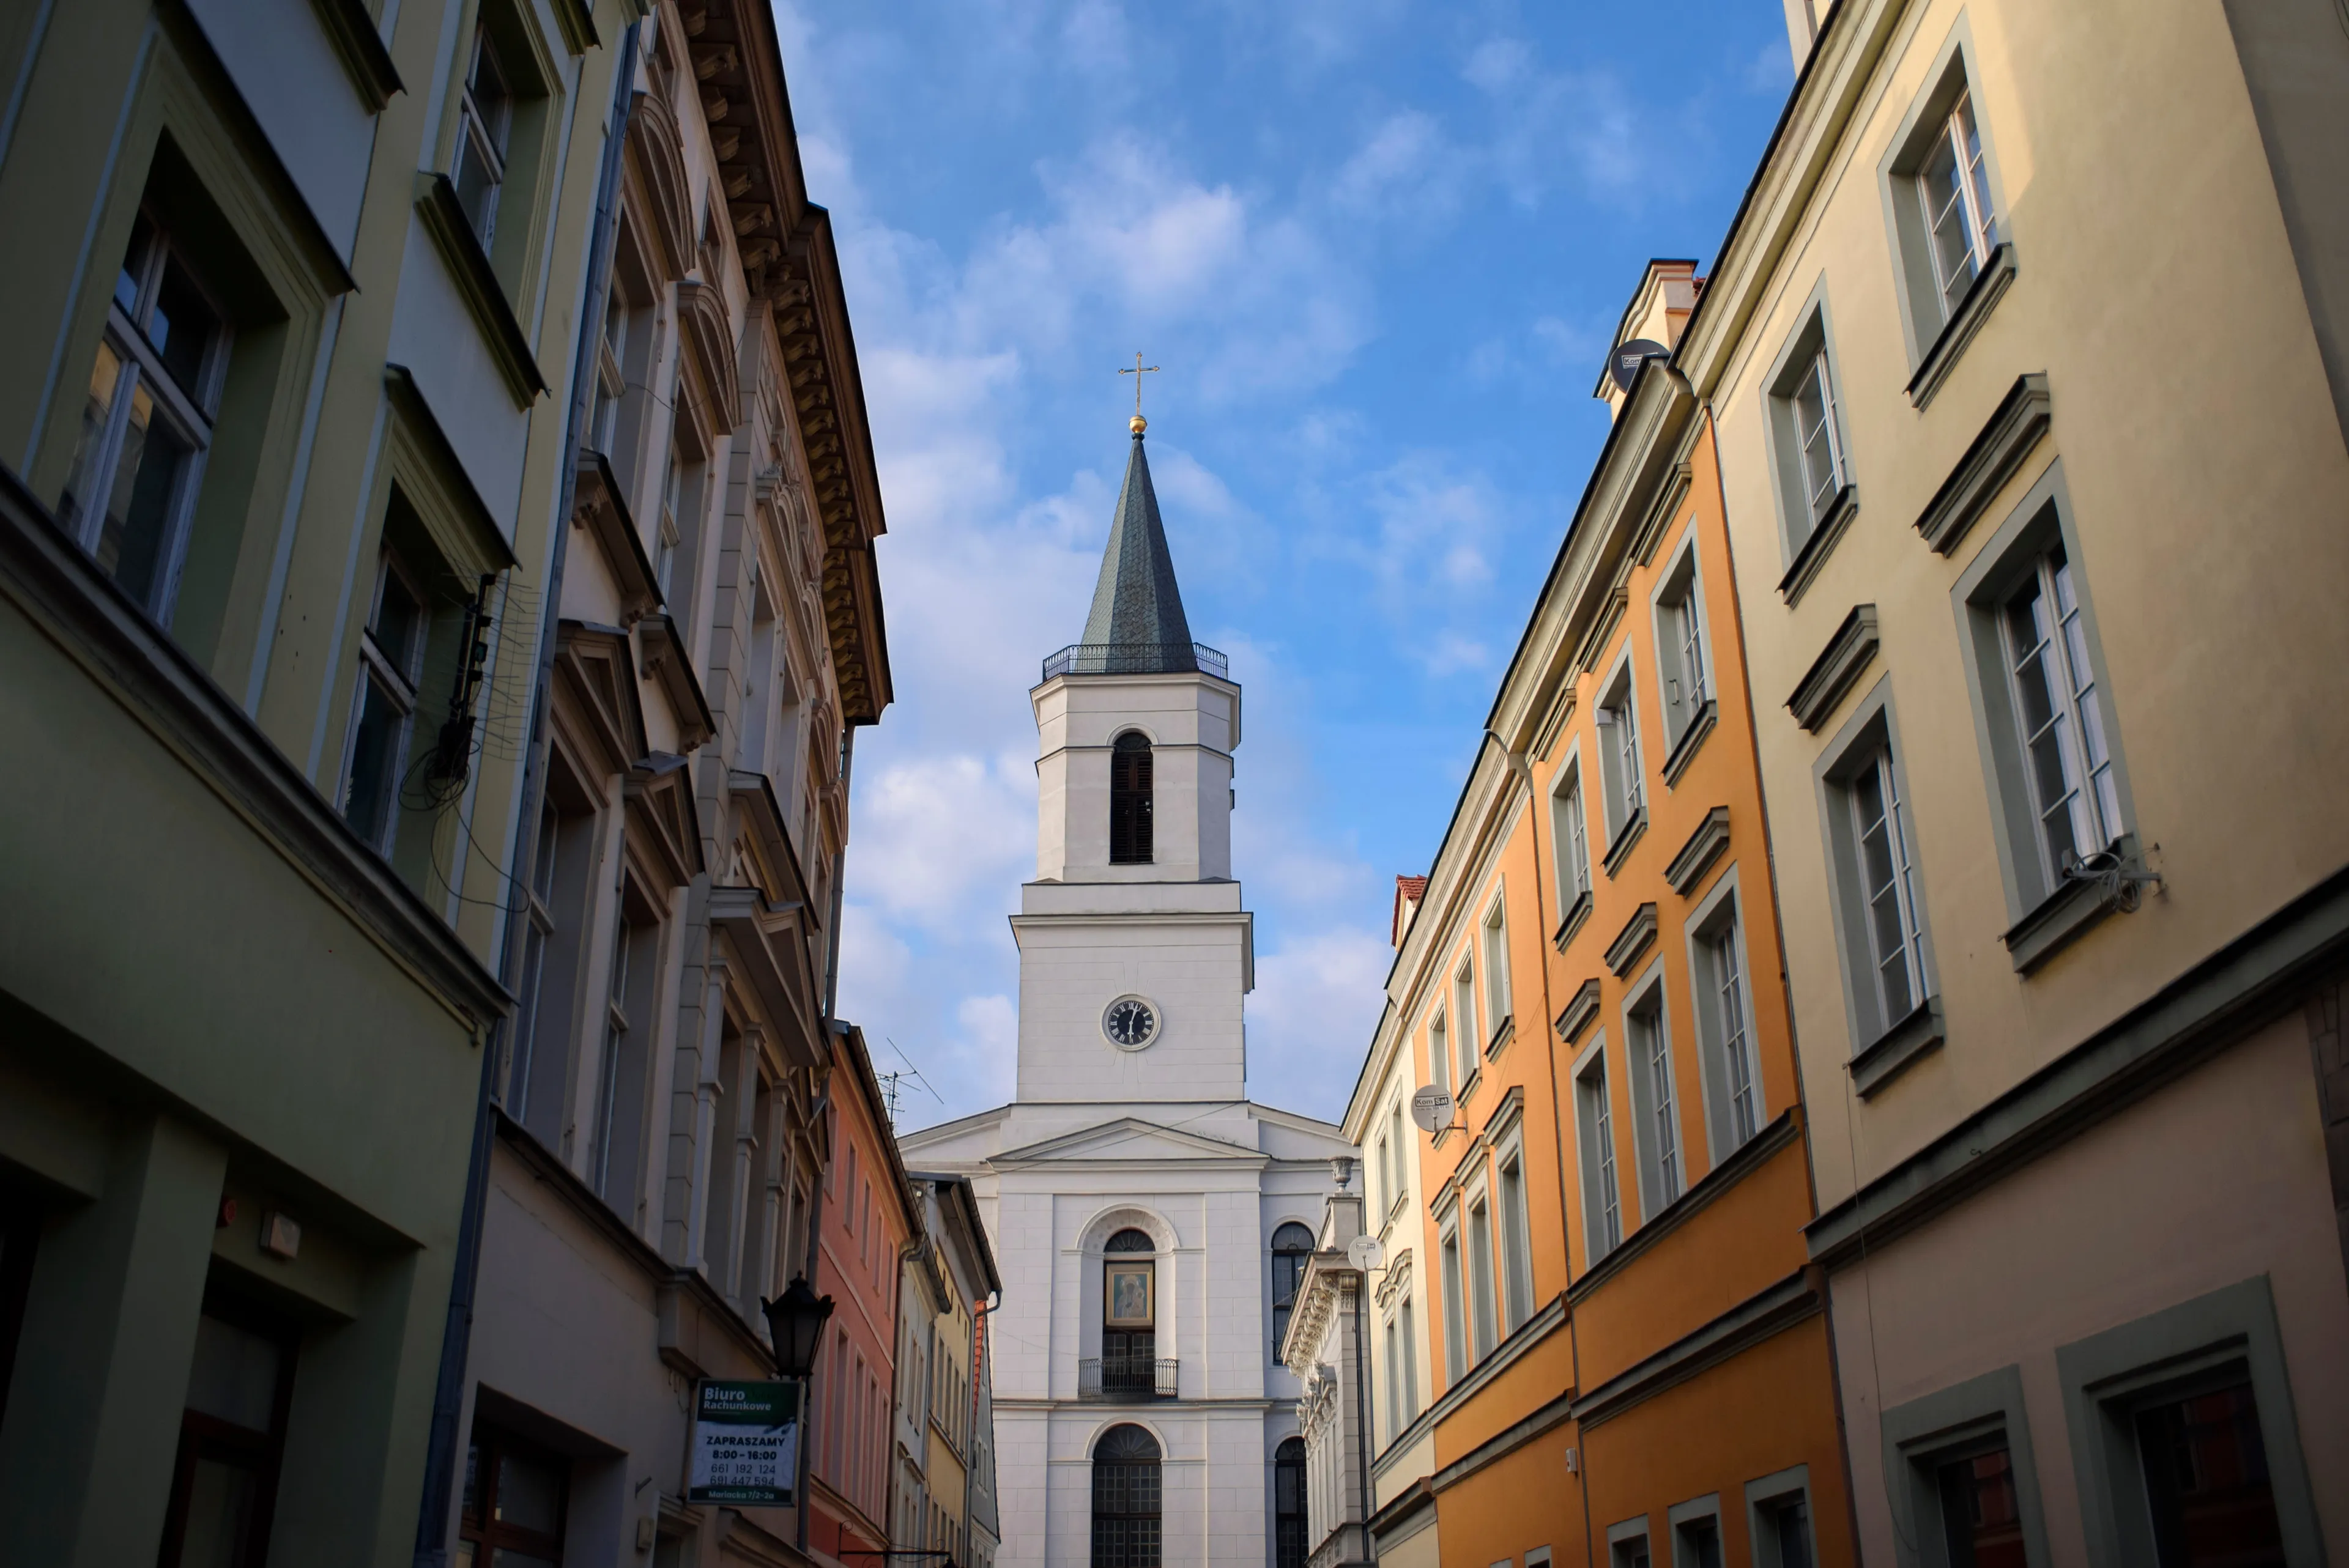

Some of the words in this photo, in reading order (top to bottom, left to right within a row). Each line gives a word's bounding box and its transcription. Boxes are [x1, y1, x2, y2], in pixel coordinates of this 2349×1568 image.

[705, 1387, 746, 1400] Biuro
[703, 1400, 771, 1411] Rachunkowe
[707, 1435, 785, 1447] ZAPRASZAMY
[712, 1450, 738, 1460] 8:00
[748, 1451, 777, 1460] 16:00
[711, 1463, 729, 1473] 661
[736, 1464, 752, 1474] 192
[759, 1465, 776, 1474] 124
[710, 1475, 727, 1485] 691
[731, 1476, 751, 1485] 447
[754, 1476, 775, 1486] 594
[708, 1490, 746, 1499] Mariacka
[748, 1491, 774, 1500] 7/2-2a
